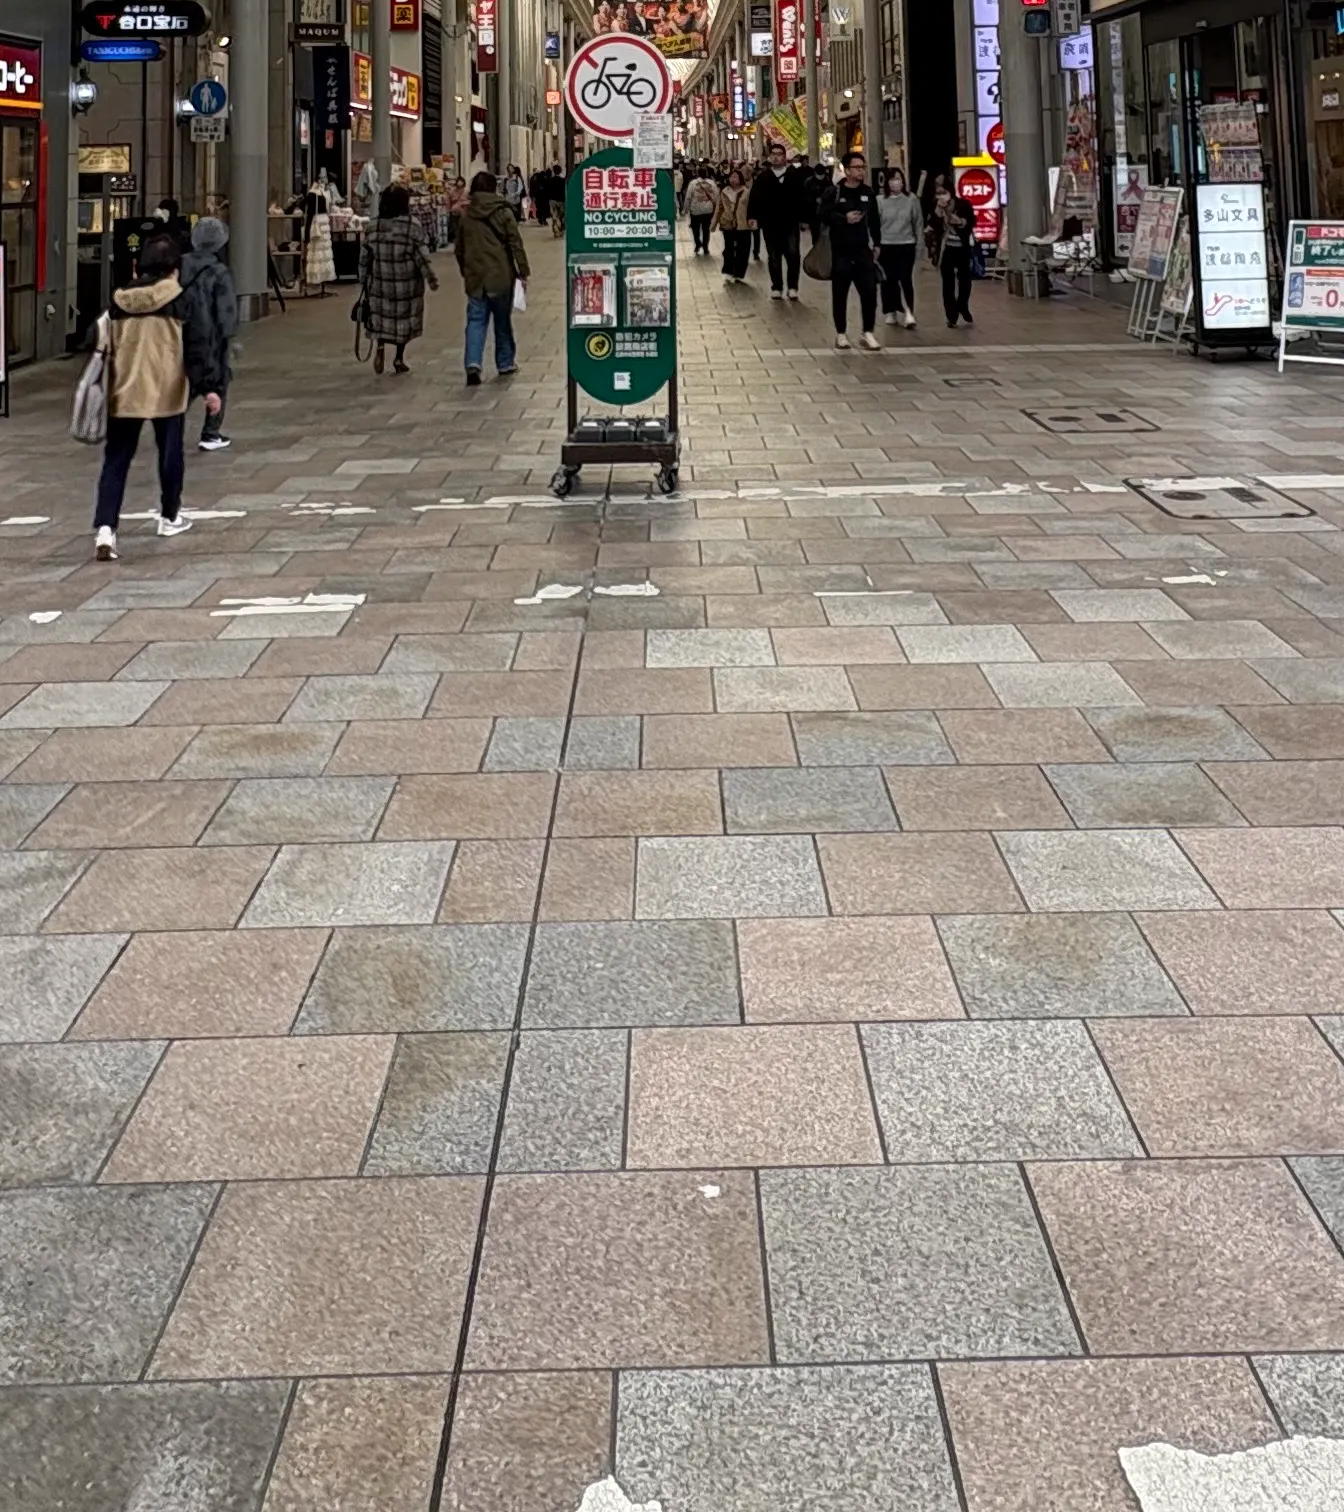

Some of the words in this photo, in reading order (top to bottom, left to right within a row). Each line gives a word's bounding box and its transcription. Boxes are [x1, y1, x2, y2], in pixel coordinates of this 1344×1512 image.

[119, 14, 189, 30] 谷口宝石
[779, 5, 796, 53] Wants
[584, 167, 657, 191] 自転車
[962, 184, 992, 196] ガスト
[584, 191, 657, 210] 通行禁止
[584, 212, 603, 223] NO
[604, 212, 657, 223] CYCLING
[1204, 208, 1260, 222] 多山文具
